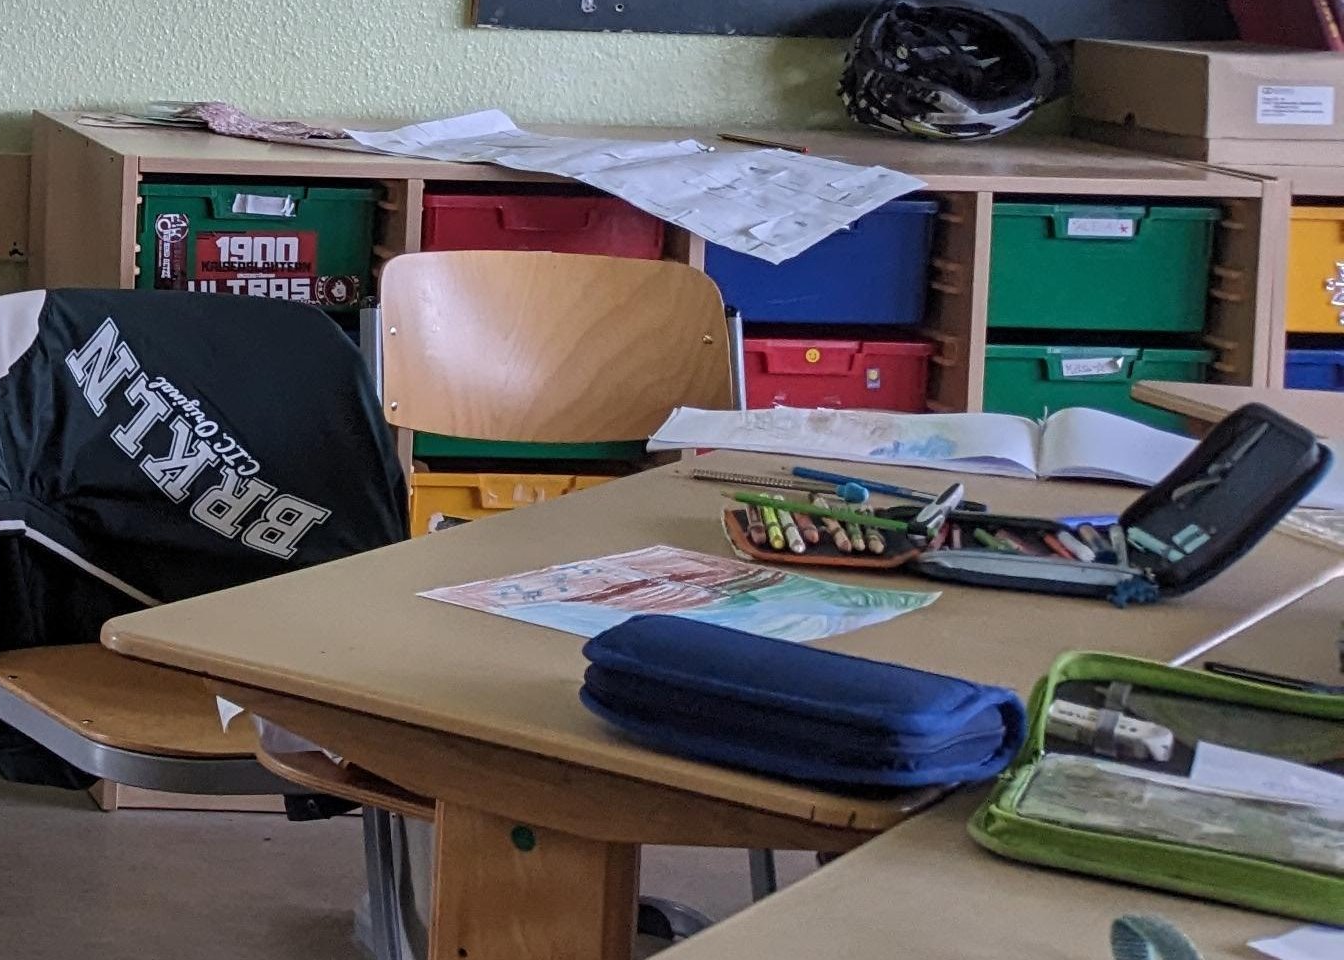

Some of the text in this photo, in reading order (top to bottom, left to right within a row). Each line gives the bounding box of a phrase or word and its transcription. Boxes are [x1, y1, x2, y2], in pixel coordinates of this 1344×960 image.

[216, 236, 299, 267] 1900
[148, 375, 220, 435] Original
[66, 317, 332, 560] BRKLN
